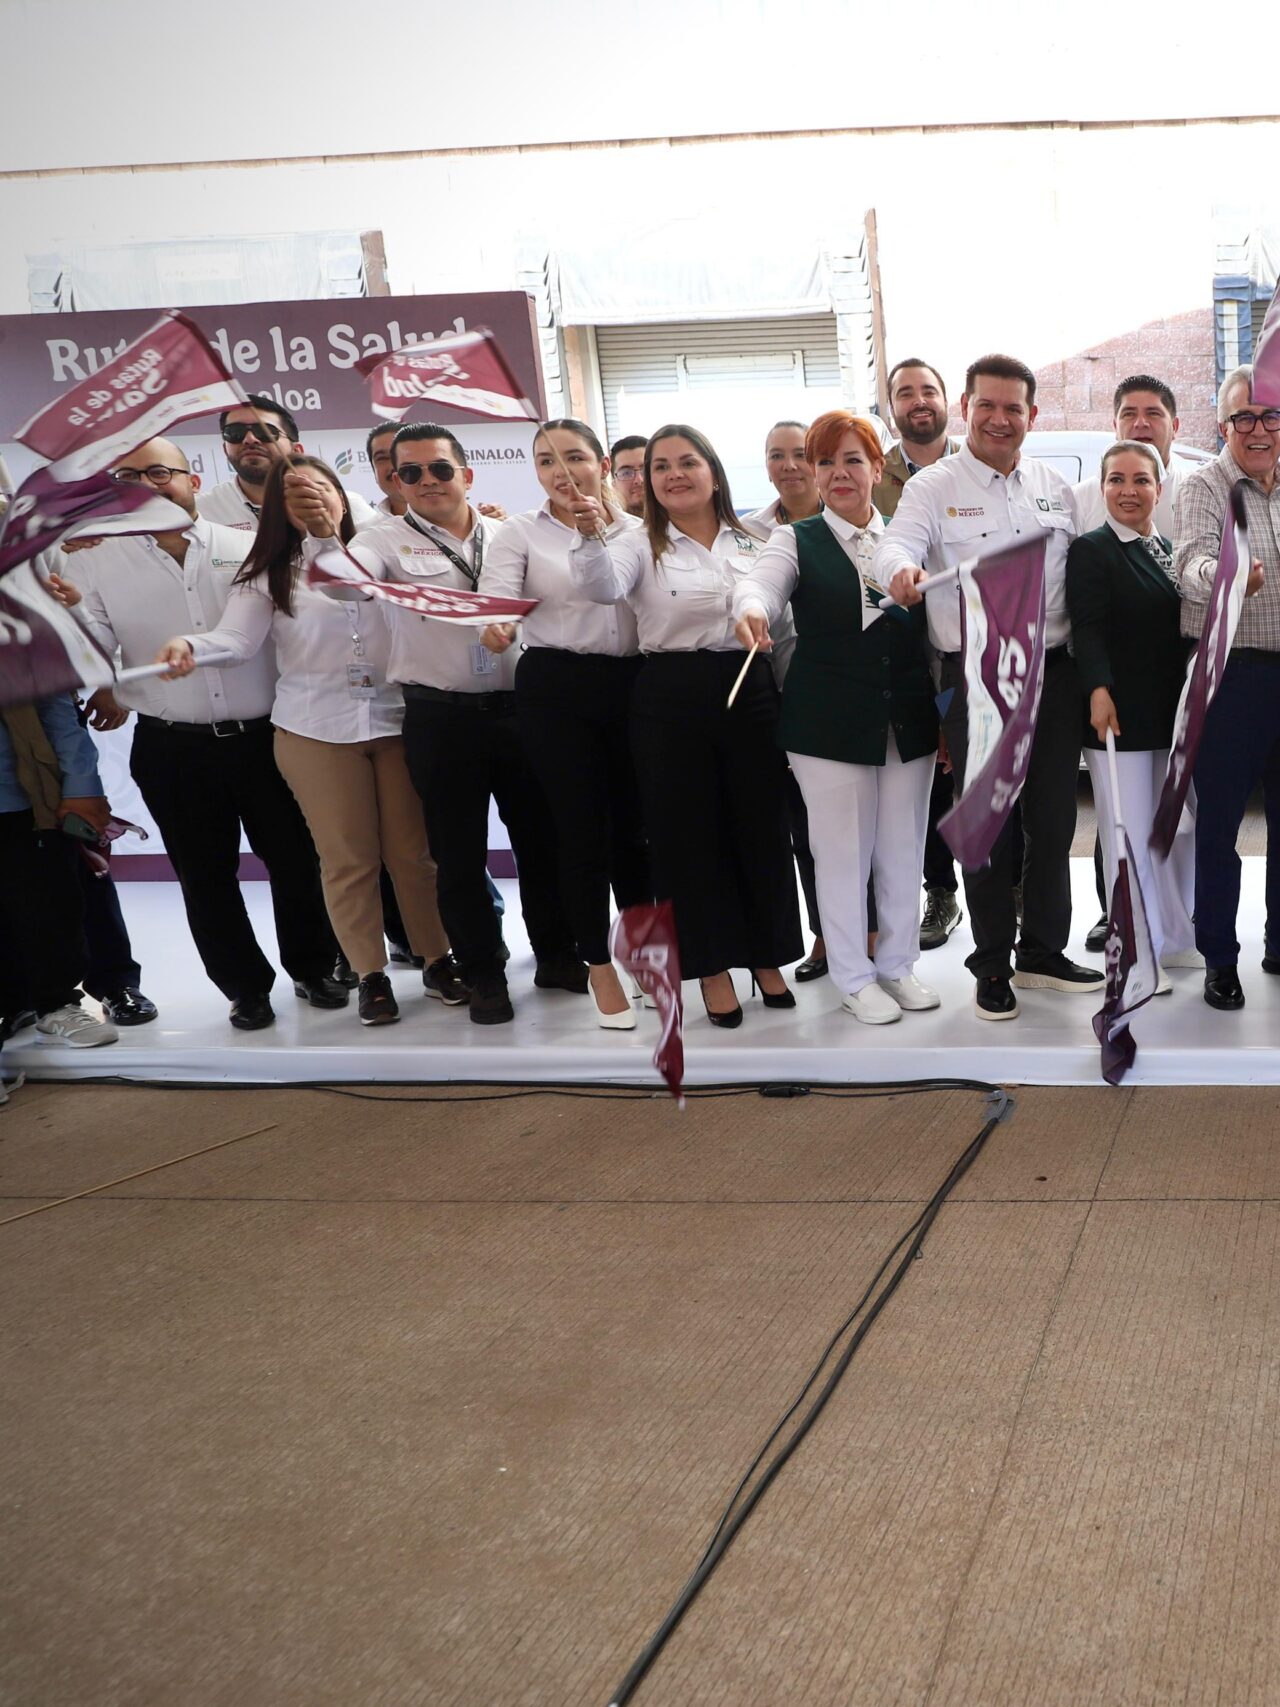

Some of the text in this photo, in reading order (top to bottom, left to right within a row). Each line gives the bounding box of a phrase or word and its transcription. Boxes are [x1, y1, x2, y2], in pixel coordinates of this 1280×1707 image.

[46, 317, 467, 382] Rut de la Sal
[252, 382, 322, 411] aloa
[463, 448, 526, 460] SINALOA
